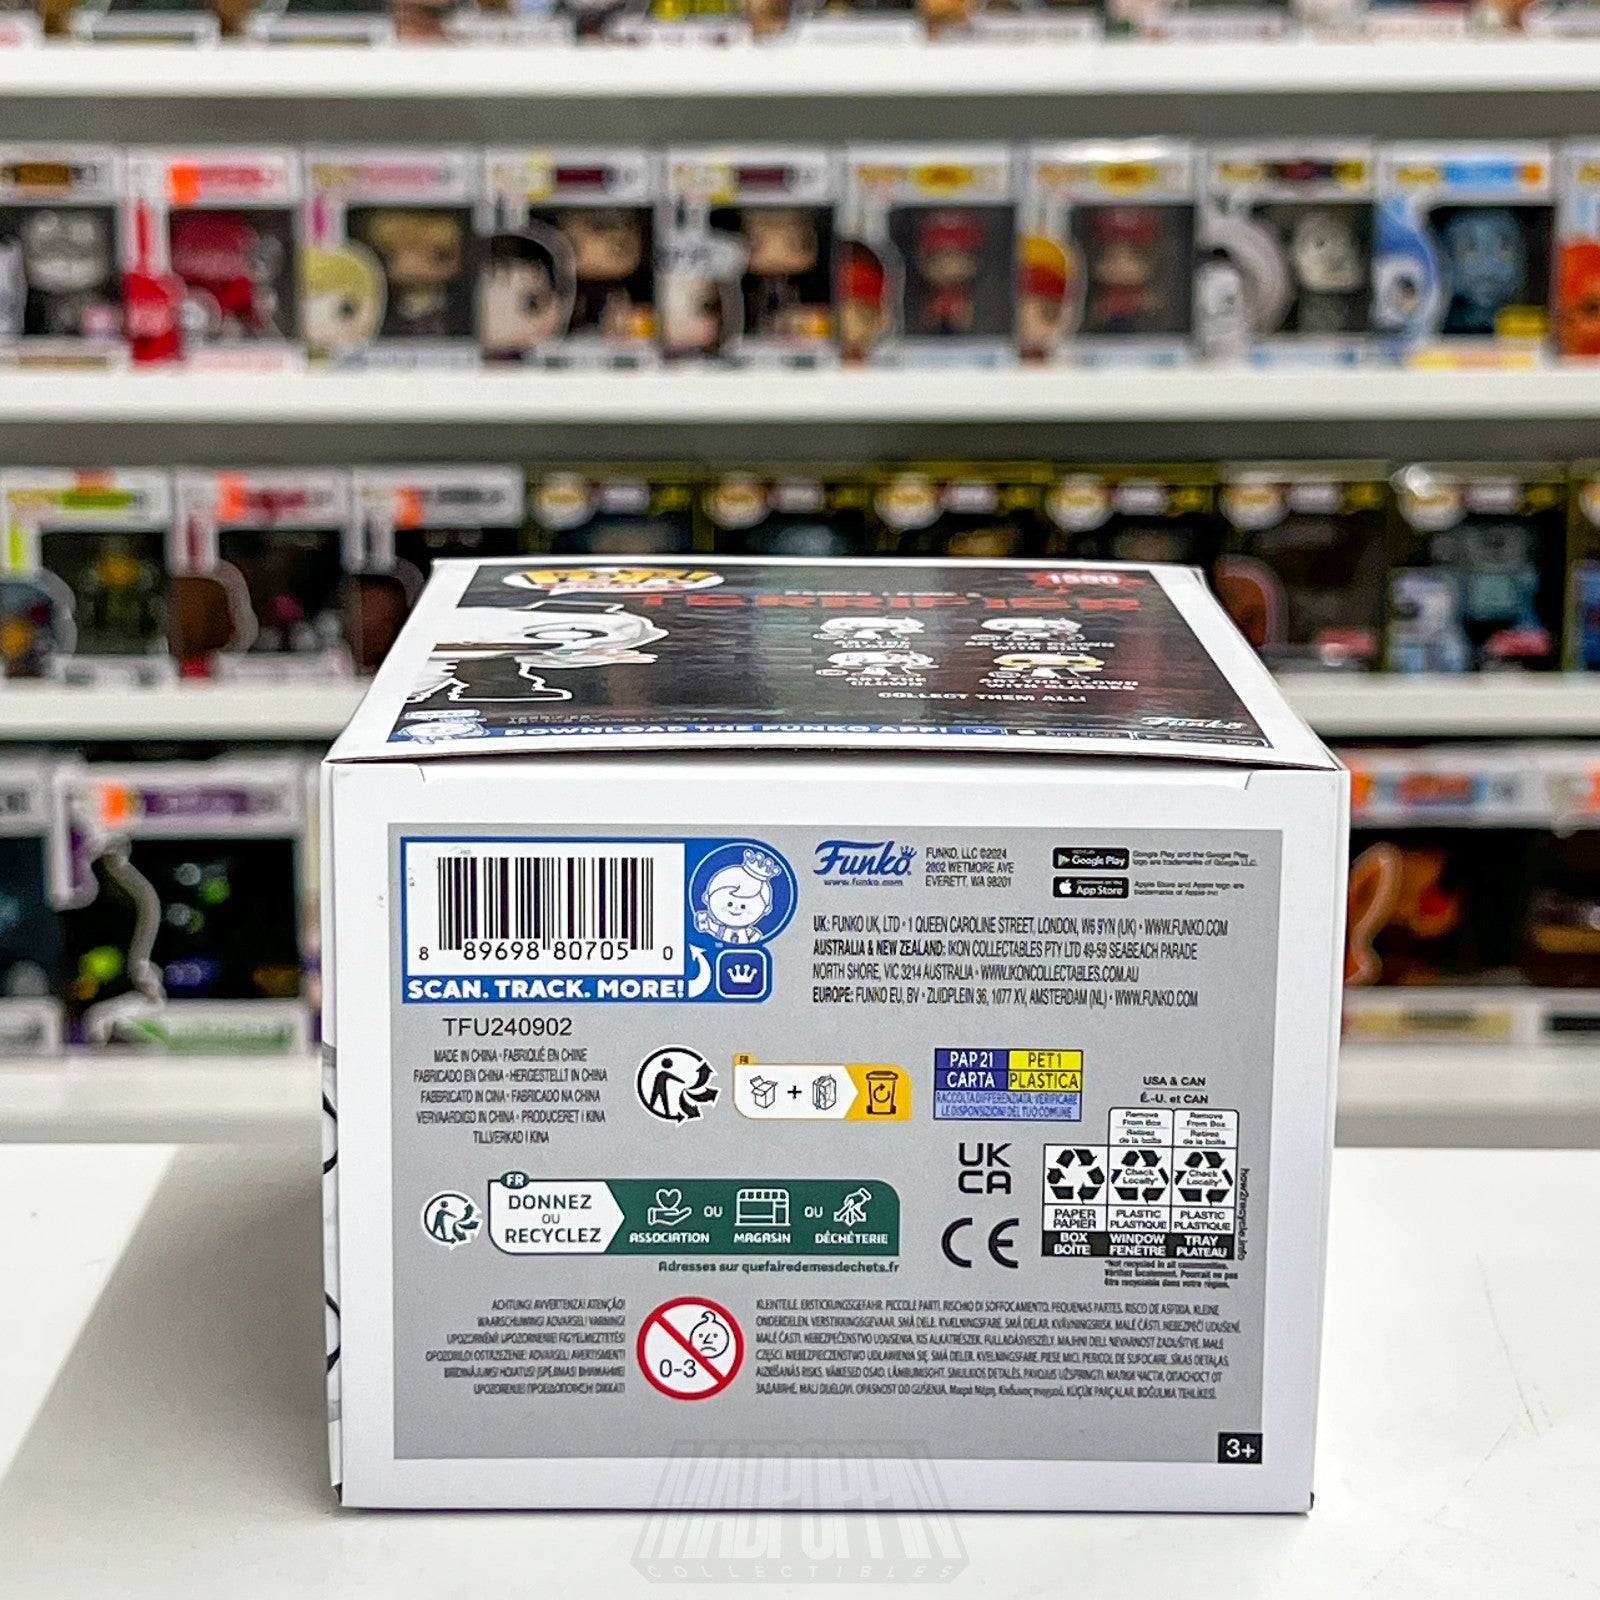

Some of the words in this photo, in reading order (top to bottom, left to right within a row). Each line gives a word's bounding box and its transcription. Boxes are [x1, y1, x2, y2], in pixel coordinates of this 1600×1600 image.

[975, 693, 1034, 701] THEM
[504, 725, 687, 736] DOWNLOAD
[762, 724, 870, 732] FUNKO
[813, 839, 913, 876] Funko
[961, 847, 978, 860] LLC
[1071, 855, 1104, 867] Google
[1106, 855, 1126, 867] Play
[997, 863, 1014, 874] AVE
[1076, 886, 1097, 896] App
[1098, 886, 1123, 896] Store
[813, 915, 830, 932] UK:
[832, 915, 864, 932] FUNKO
[883, 915, 901, 932] LTD
[915, 915, 948, 933] QUEEN
[950, 916, 996, 933] CAROLINE
[998, 916, 1036, 935] STREET,
[1037, 916, 1079, 936] LONDON,
[1117, 918, 1137, 938] (UK)
[1144, 918, 1228, 936] WWW.FUNKO.COM
[419, 946, 429, 961] 8
[463, 941, 541, 961] 89698
[554, 941, 629, 961] 80705
[662, 947, 673, 961] 0
[813, 938, 865, 956] AUSTRALIA
[867, 939, 873, 956] &
[876, 939, 898, 956] NEW
[899, 939, 946, 956] ZEALAND:
[972, 939, 1043, 957] COLLECTABLES
[1044, 940, 1063, 957] PTY
[1064, 941, 1082, 957] LTD
[1109, 941, 1158, 958] SEABEACH
[1160, 943, 1198, 960] PARADE
[813, 963, 845, 980] NORTH
[884, 963, 899, 980] VIC
[923, 963, 974, 981] AUSTRALIA
[407, 979, 489, 999] SCAN.
[494, 979, 591, 999] TRACK.
[598, 979, 685, 999] MORE!
[813, 986, 854, 1003] EUROPE:
[856, 986, 888, 1003] FUNKO
[907, 987, 919, 1004] BV
[992, 988, 1012, 1004] 1077
[1029, 988, 1088, 1005] AMSTERDAM
[1115, 989, 1198, 1007] WWW.FUNKO.COM
[442, 1017, 573, 1037] TFU240902
[434, 1049, 459, 1062] MADE
[461, 1049, 470, 1062] IN
[471, 1049, 498, 1062] CHINA
[547, 1048, 560, 1062] EN
[561, 1048, 588, 1062] CHINE
[949, 1051, 978, 1068] PAP
[980, 1051, 993, 1068] 21
[464, 1069, 476, 1082] EN
[477, 1069, 504, 1082] CHINA
[571, 1068, 580, 1082] IN
[581, 1068, 608, 1082] CHINA
[946, 1071, 995, 1088] CARTA
[1009, 1072, 1079, 1089] PLASTICA
[1143, 1076, 1167, 1086] USA
[1169, 1077, 1178, 1086] &
[1180, 1077, 1206, 1086] CAN
[474, 1090, 484, 1103] IN
[561, 1089, 574, 1102] NA
[574, 1089, 601, 1102] CHINA
[1169, 1095, 1181, 1104] et
[1183, 1095, 1209, 1104] CAN
[478, 1110, 487, 1123] IN
[488, 1110, 515, 1123] CHINA
[958, 1142, 1013, 1167] UK
[506, 1173, 525, 1187] FR
[957, 1170, 1013, 1195] CA
[508, 1194, 592, 1210] DONNEZ
[703, 1206, 723, 1218] OU
[804, 1206, 824, 1218] OU
[1054, 1208, 1096, 1219] PAPER
[1116, 1209, 1162, 1219] PLASTIC
[1180, 1211, 1226, 1221] PLASTIC
[541, 1213, 561, 1225] OU
[1053, 1218, 1096, 1229] PAPIER
[1109, 1220, 1167, 1230] PLASTIQUE
[1174, 1221, 1231, 1231] PLASTIQUE
[505, 1228, 602, 1244] RECYCLEZ
[629, 1232, 710, 1244] ASSOCIATION
[733, 1232, 791, 1244] MAGASIN
[1060, 1232, 1088, 1244] BOX
[1109, 1233, 1166, 1245] WINDOW
[1184, 1234, 1219, 1246] TRAY
[941, 1217, 1020, 1269] CE
[1176, 1246, 1228, 1258] PLATEAU
[658, 1261, 716, 1272] Adresses
[719, 1263, 738, 1273] sur
[742, 1261, 900, 1275] quefairedemesdechets.fr
[659, 1358, 697, 1378] 0-3
[1225, 1438, 1256, 1459] 3+
